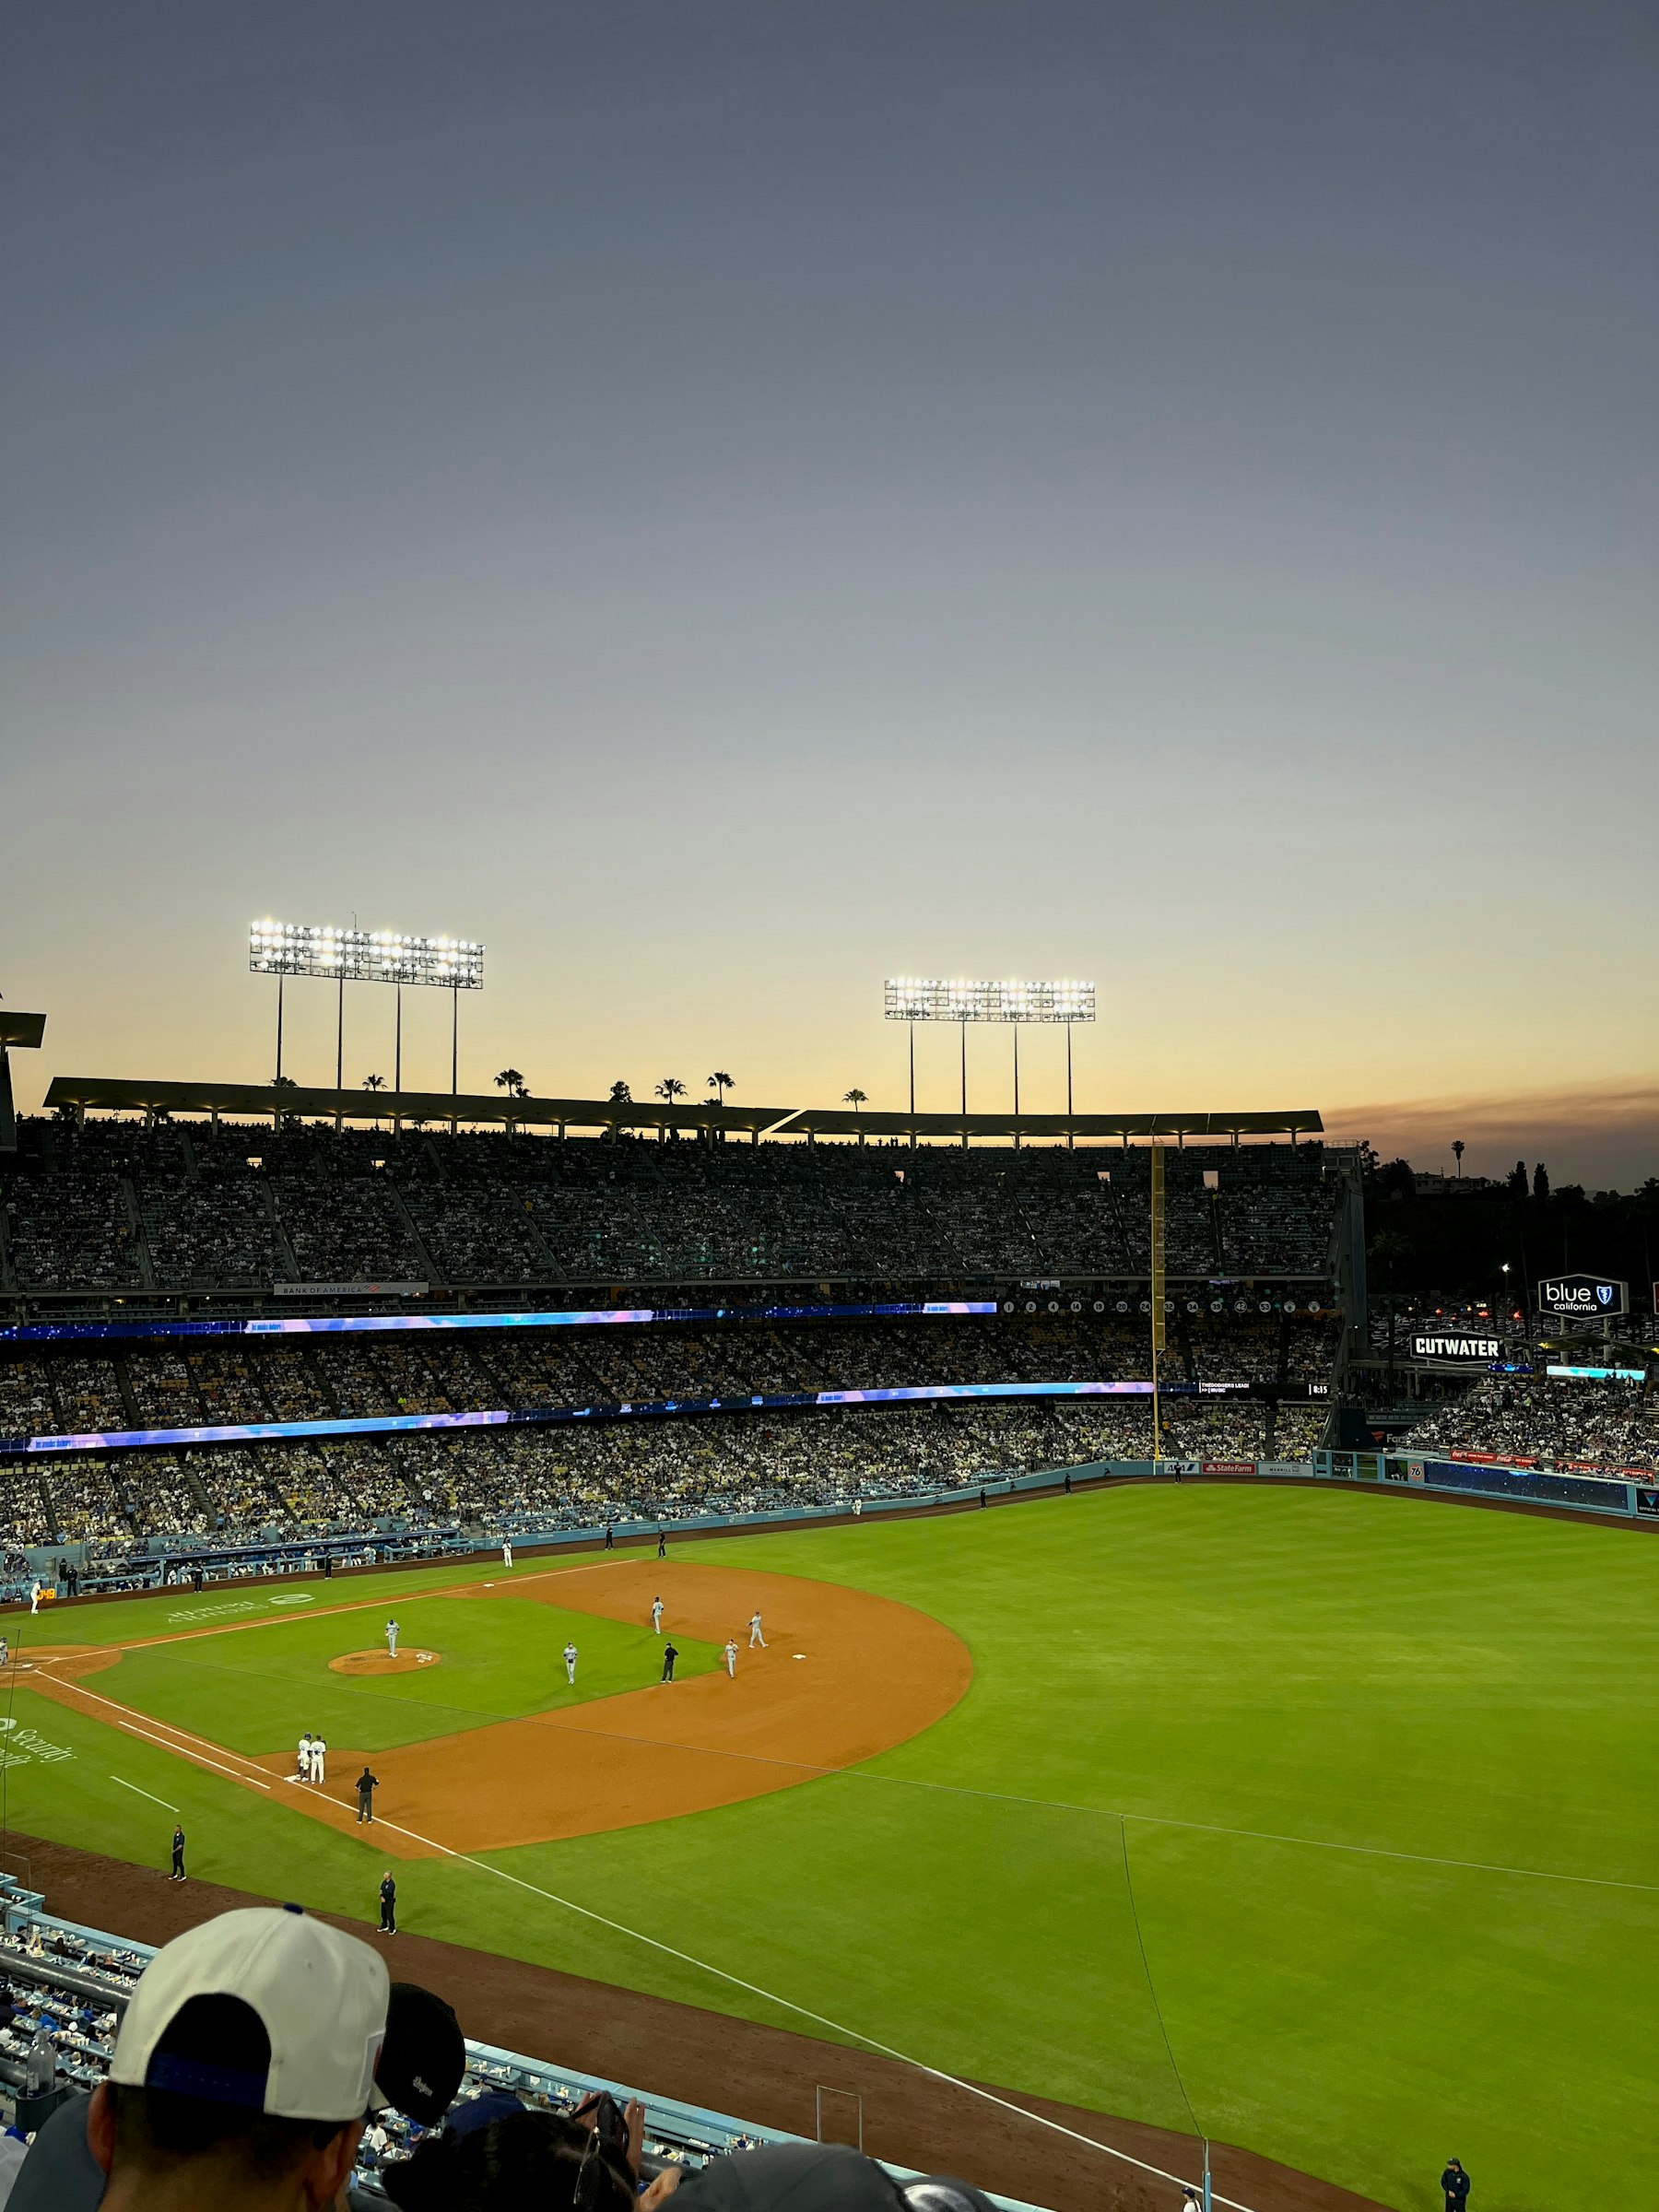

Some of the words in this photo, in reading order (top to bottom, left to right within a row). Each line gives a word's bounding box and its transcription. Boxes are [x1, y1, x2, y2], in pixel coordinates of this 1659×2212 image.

[1546, 1283, 1591, 1301] blue
[1553, 1301, 1597, 1312] california
[1416, 1337, 1499, 1357] CUTWATER
[1312, 1385, 1327, 1394] 8:15
[1410, 1467, 1421, 1477] 76
[4, 1729, 77, 1762] Security
